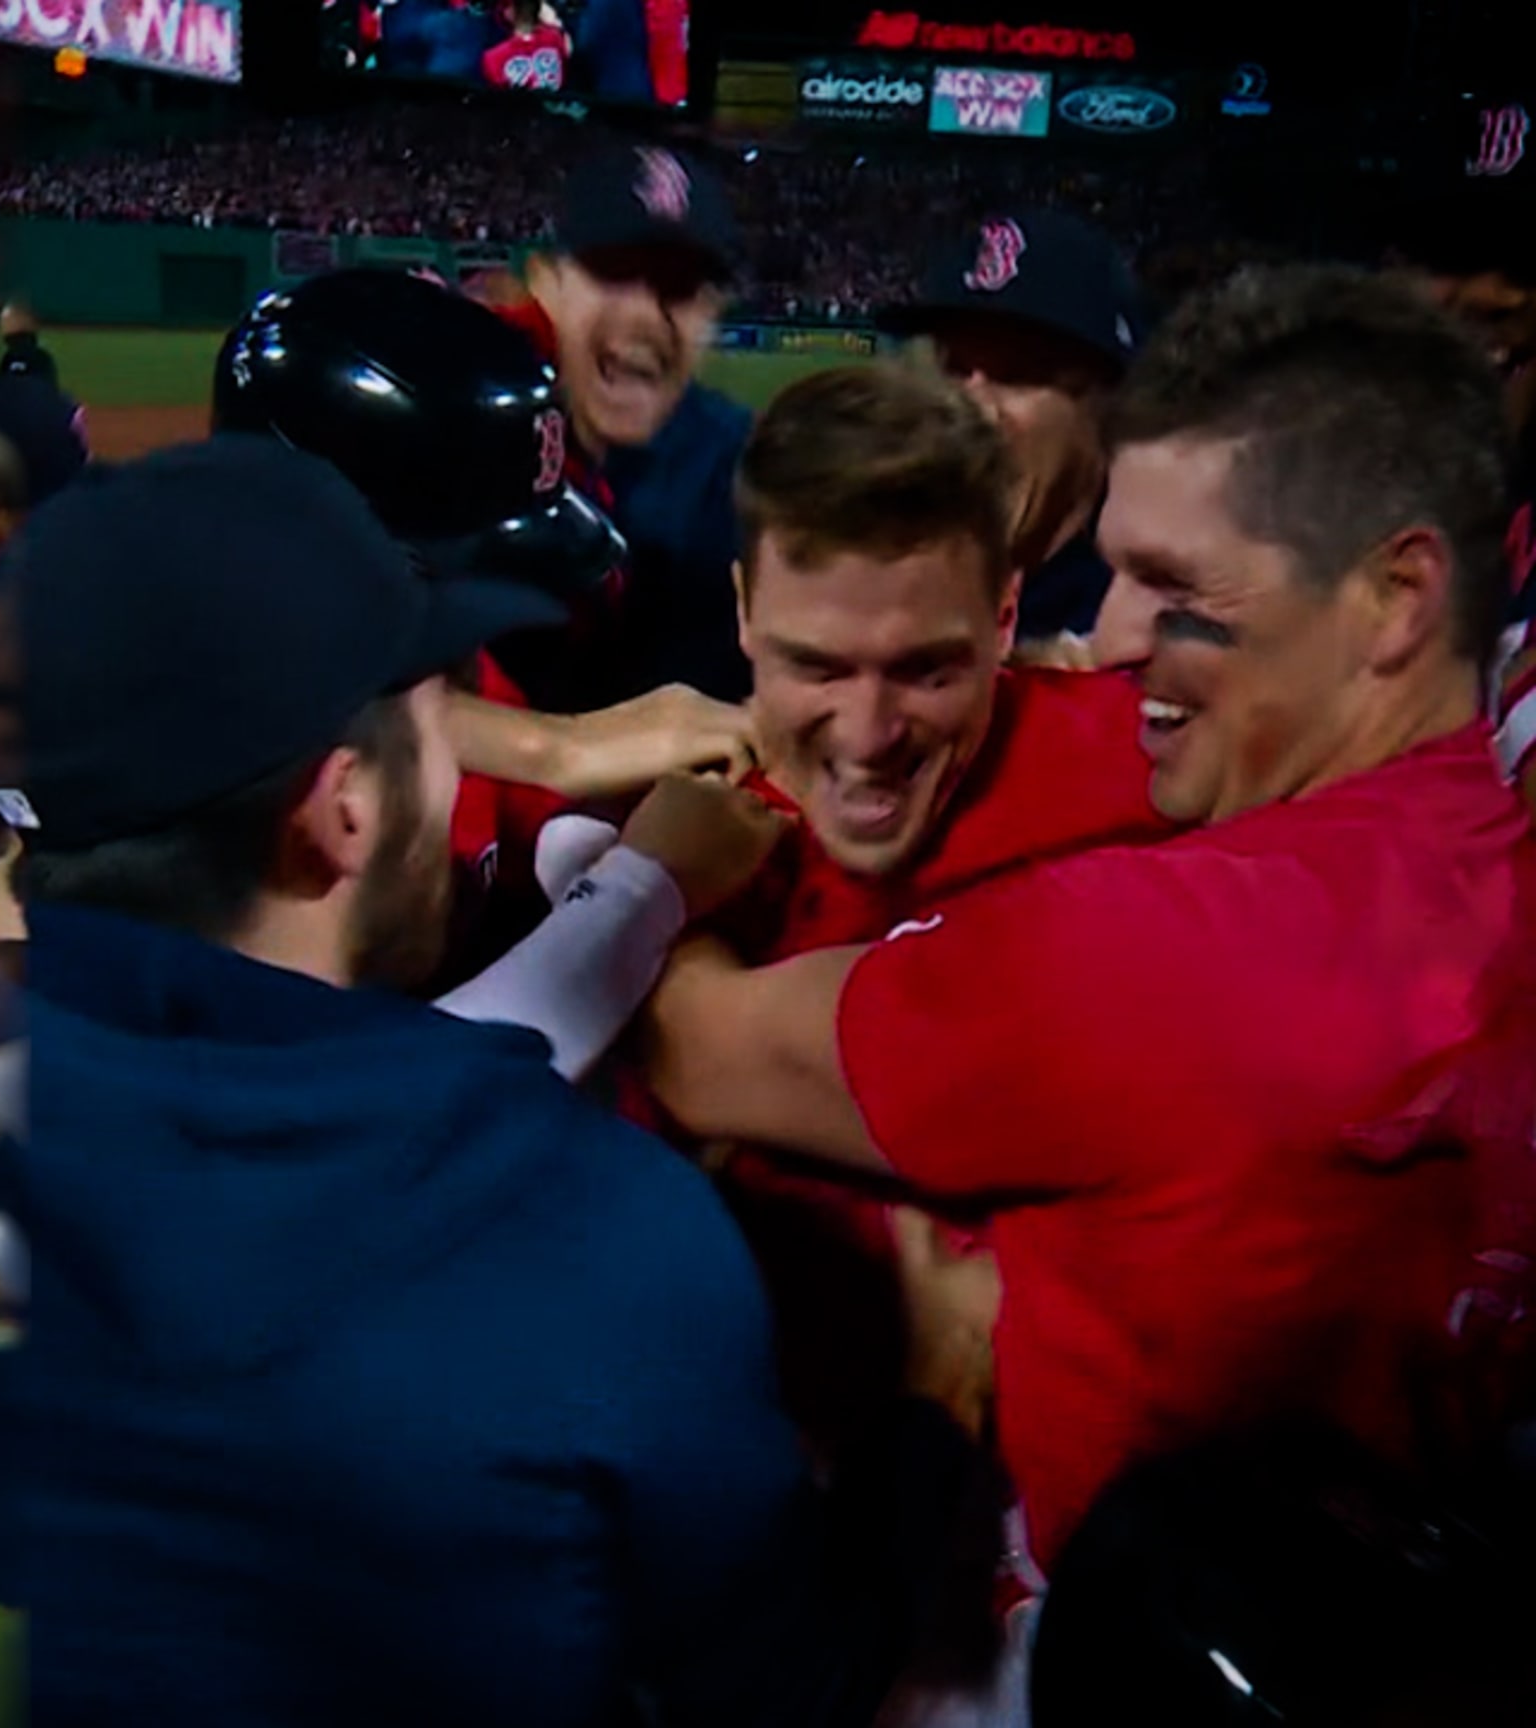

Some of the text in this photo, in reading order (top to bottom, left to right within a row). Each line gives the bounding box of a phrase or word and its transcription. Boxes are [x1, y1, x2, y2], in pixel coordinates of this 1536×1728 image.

[801, 71, 925, 107] airocide
[958, 98, 1024, 131] WIN
[1080, 92, 1153, 127] Ford
